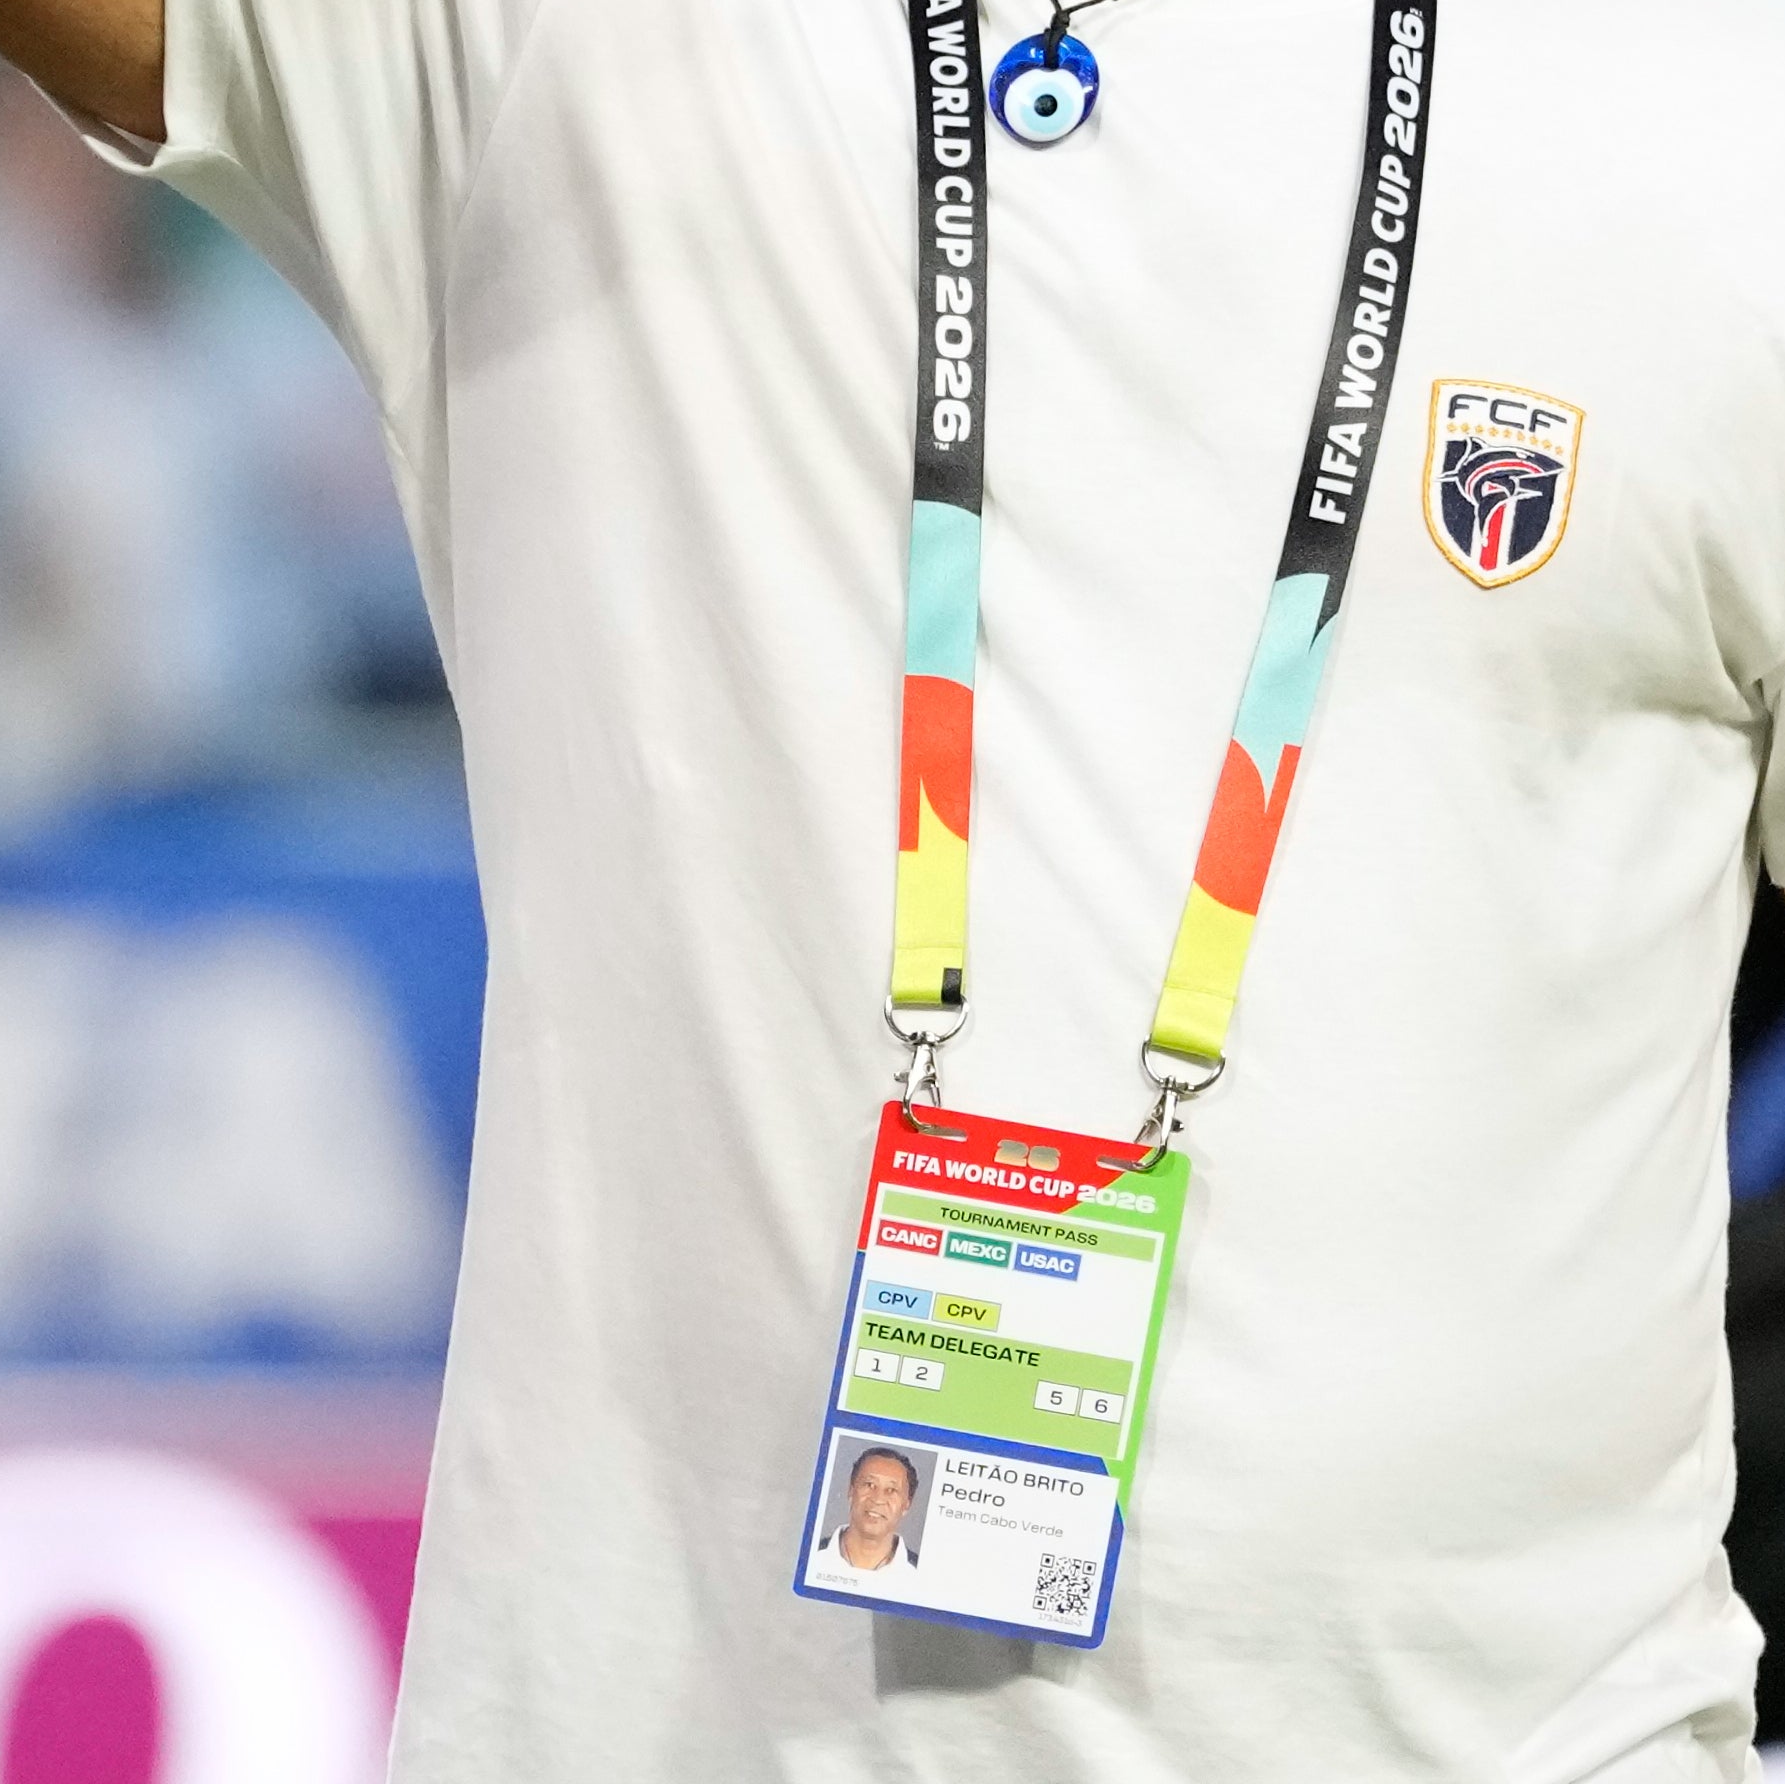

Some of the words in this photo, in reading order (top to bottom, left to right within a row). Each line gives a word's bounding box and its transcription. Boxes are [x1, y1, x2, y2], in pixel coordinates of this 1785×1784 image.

[927, 20, 972, 168] WORLD
[1383, 10, 1425, 156] 2026
[934, 175, 973, 267] CUP
[1371, 154, 1411, 243] CUP
[1335, 247, 1399, 408] WORLD
[933, 275, 973, 442] 2026
[1447, 393, 1567, 433] FCF
[1309, 422, 1367, 524] FIFA
[893, 1151, 941, 1176] FIFA
[945, 1162, 1027, 1192] WORLD
[1029, 1176, 1074, 1199] CUP
[1076, 1184, 1157, 1214] 2026
[881, 1226, 938, 1249] CANC
[949, 1238, 1007, 1261] MEXC
[1020, 1251, 1074, 1274] USAC
[940, 1207, 1052, 1237] TOURNAMENT
[1055, 1229, 1099, 1246] PASS
[877, 1290, 918, 1309] CPV
[947, 1303, 987, 1321] CPV
[866, 1322, 925, 1346] TEAM
[930, 1334, 1041, 1367] DELEGATE
[871, 1358, 882, 1373] 1
[916, 1366, 928, 1380] 2
[1050, 1390, 1063, 1406] 5
[1094, 1398, 1108, 1414] 6
[941, 1483, 1006, 1507] Pedro
[945, 1458, 1018, 1484] LEITÃO
[1023, 1473, 1084, 1496] BRITO
[938, 1505, 977, 1522] Team
[980, 1513, 1017, 1529] Cabo
[1021, 1520, 1064, 1538] Verde
